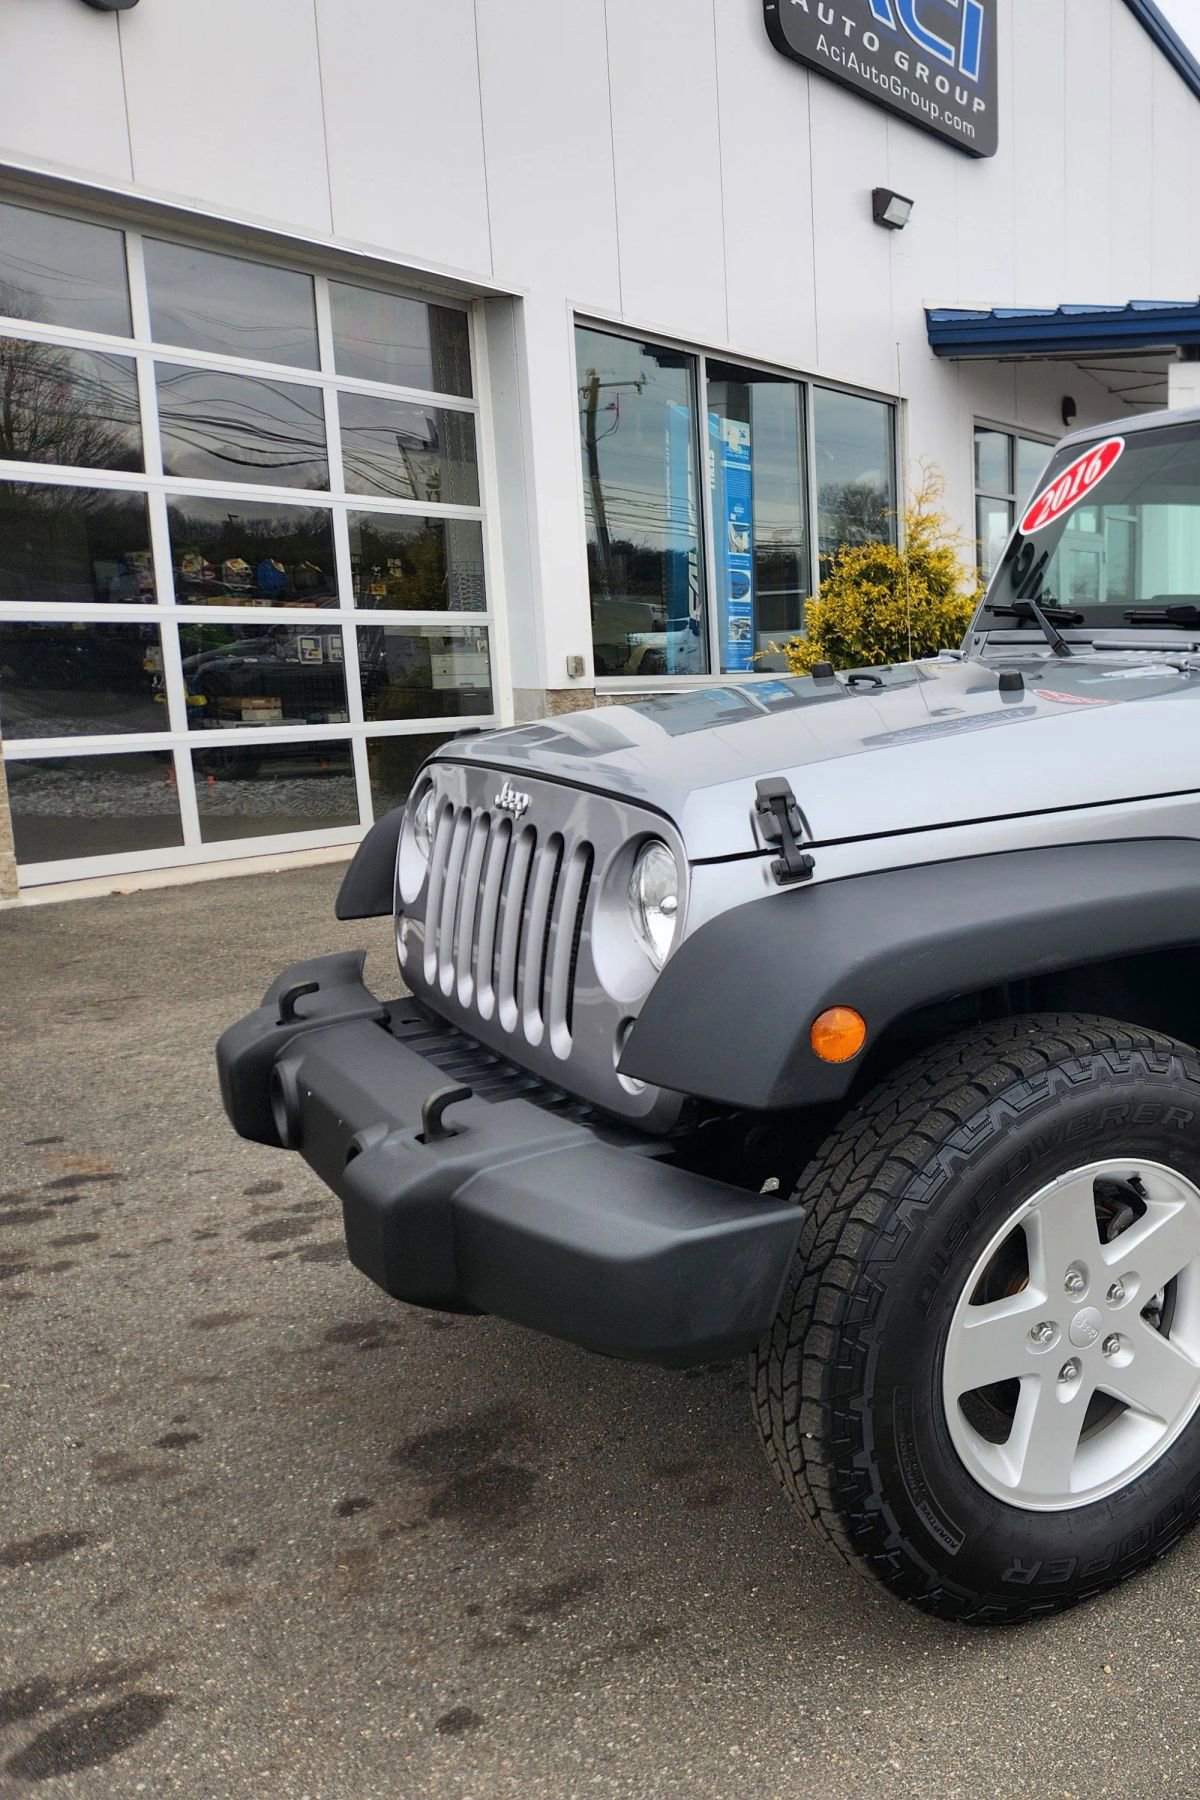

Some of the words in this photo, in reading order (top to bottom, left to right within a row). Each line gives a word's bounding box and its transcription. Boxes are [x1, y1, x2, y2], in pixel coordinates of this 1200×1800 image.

[868, 0, 984, 82] CI
[894, 51, 986, 113] GROUP
[816, 34, 975, 138] AciAutoGroup.com
[1033, 444, 1108, 528] 2016
[495, 780, 531, 820] Jeep
[914, 1102, 1195, 1320] DISCOVERER
